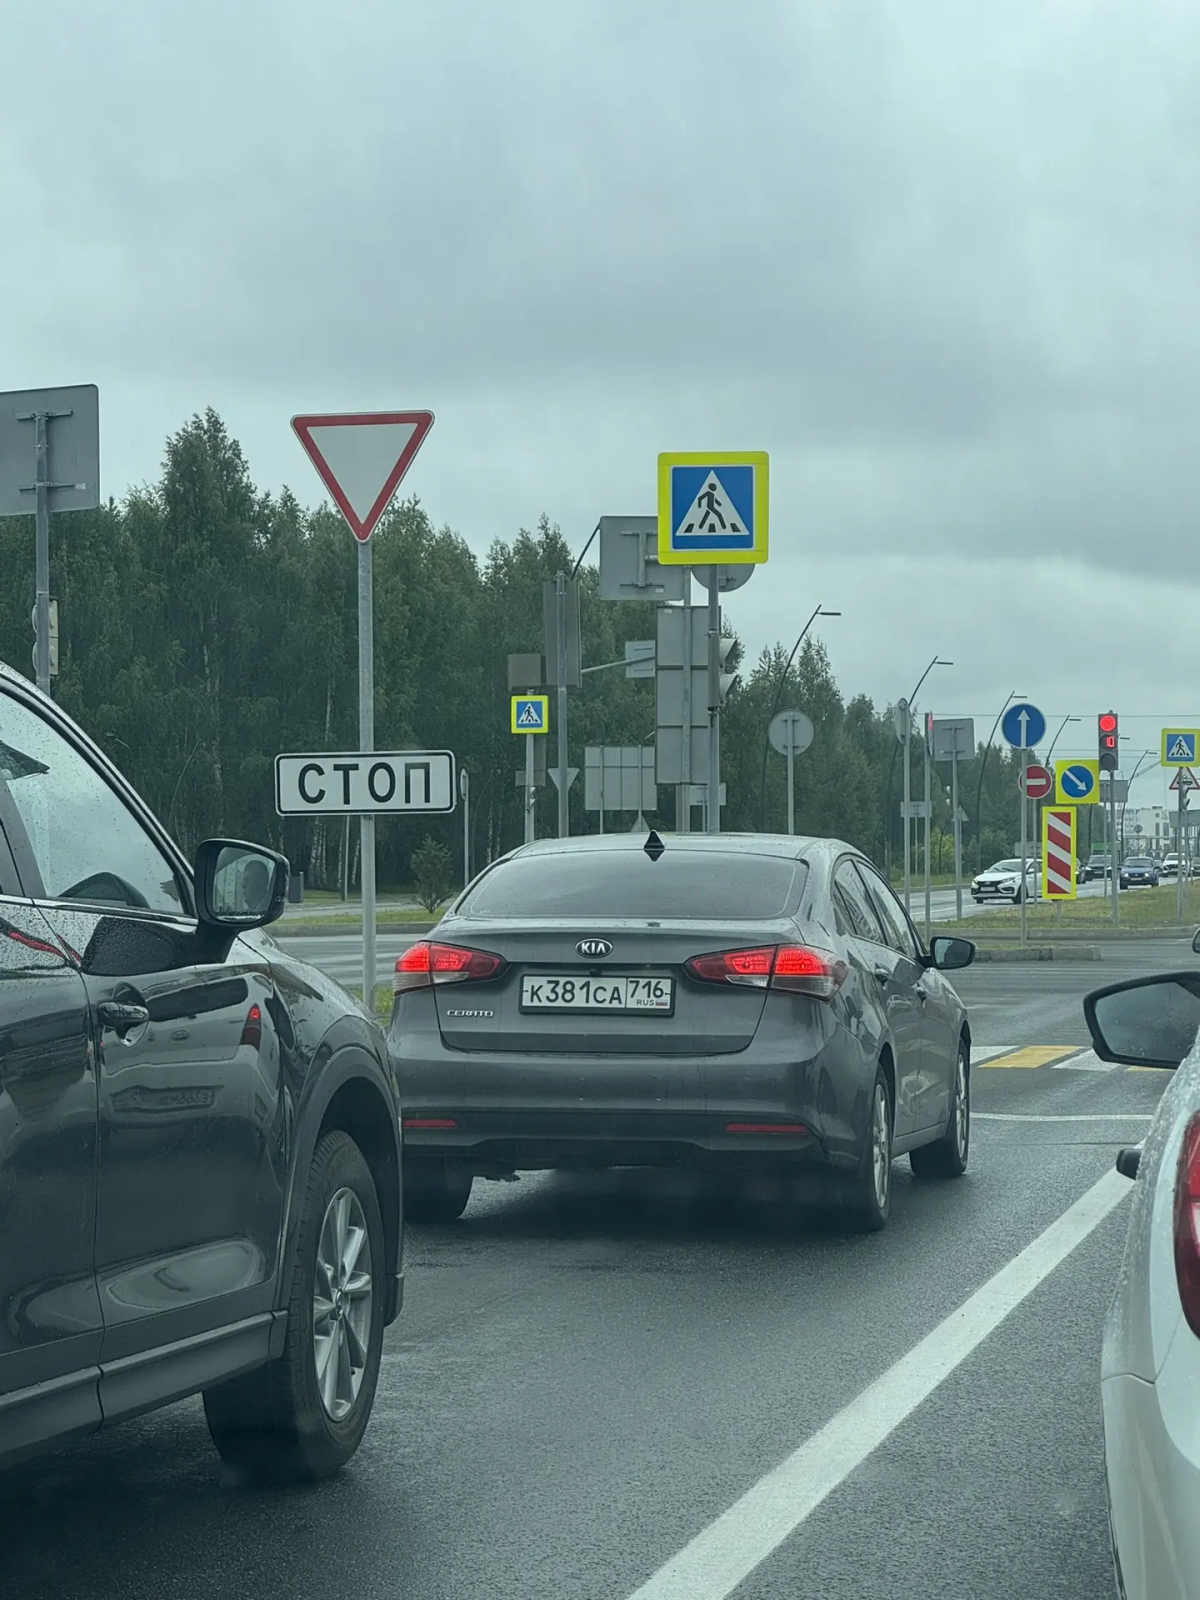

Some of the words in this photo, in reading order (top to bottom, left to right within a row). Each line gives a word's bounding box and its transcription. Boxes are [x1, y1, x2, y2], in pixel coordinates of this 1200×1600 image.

[298, 761, 431, 805] СТОП
[581, 942, 606, 954] KIA
[628, 979, 665, 998] 716
[447, 1009, 494, 1017] CERATO
